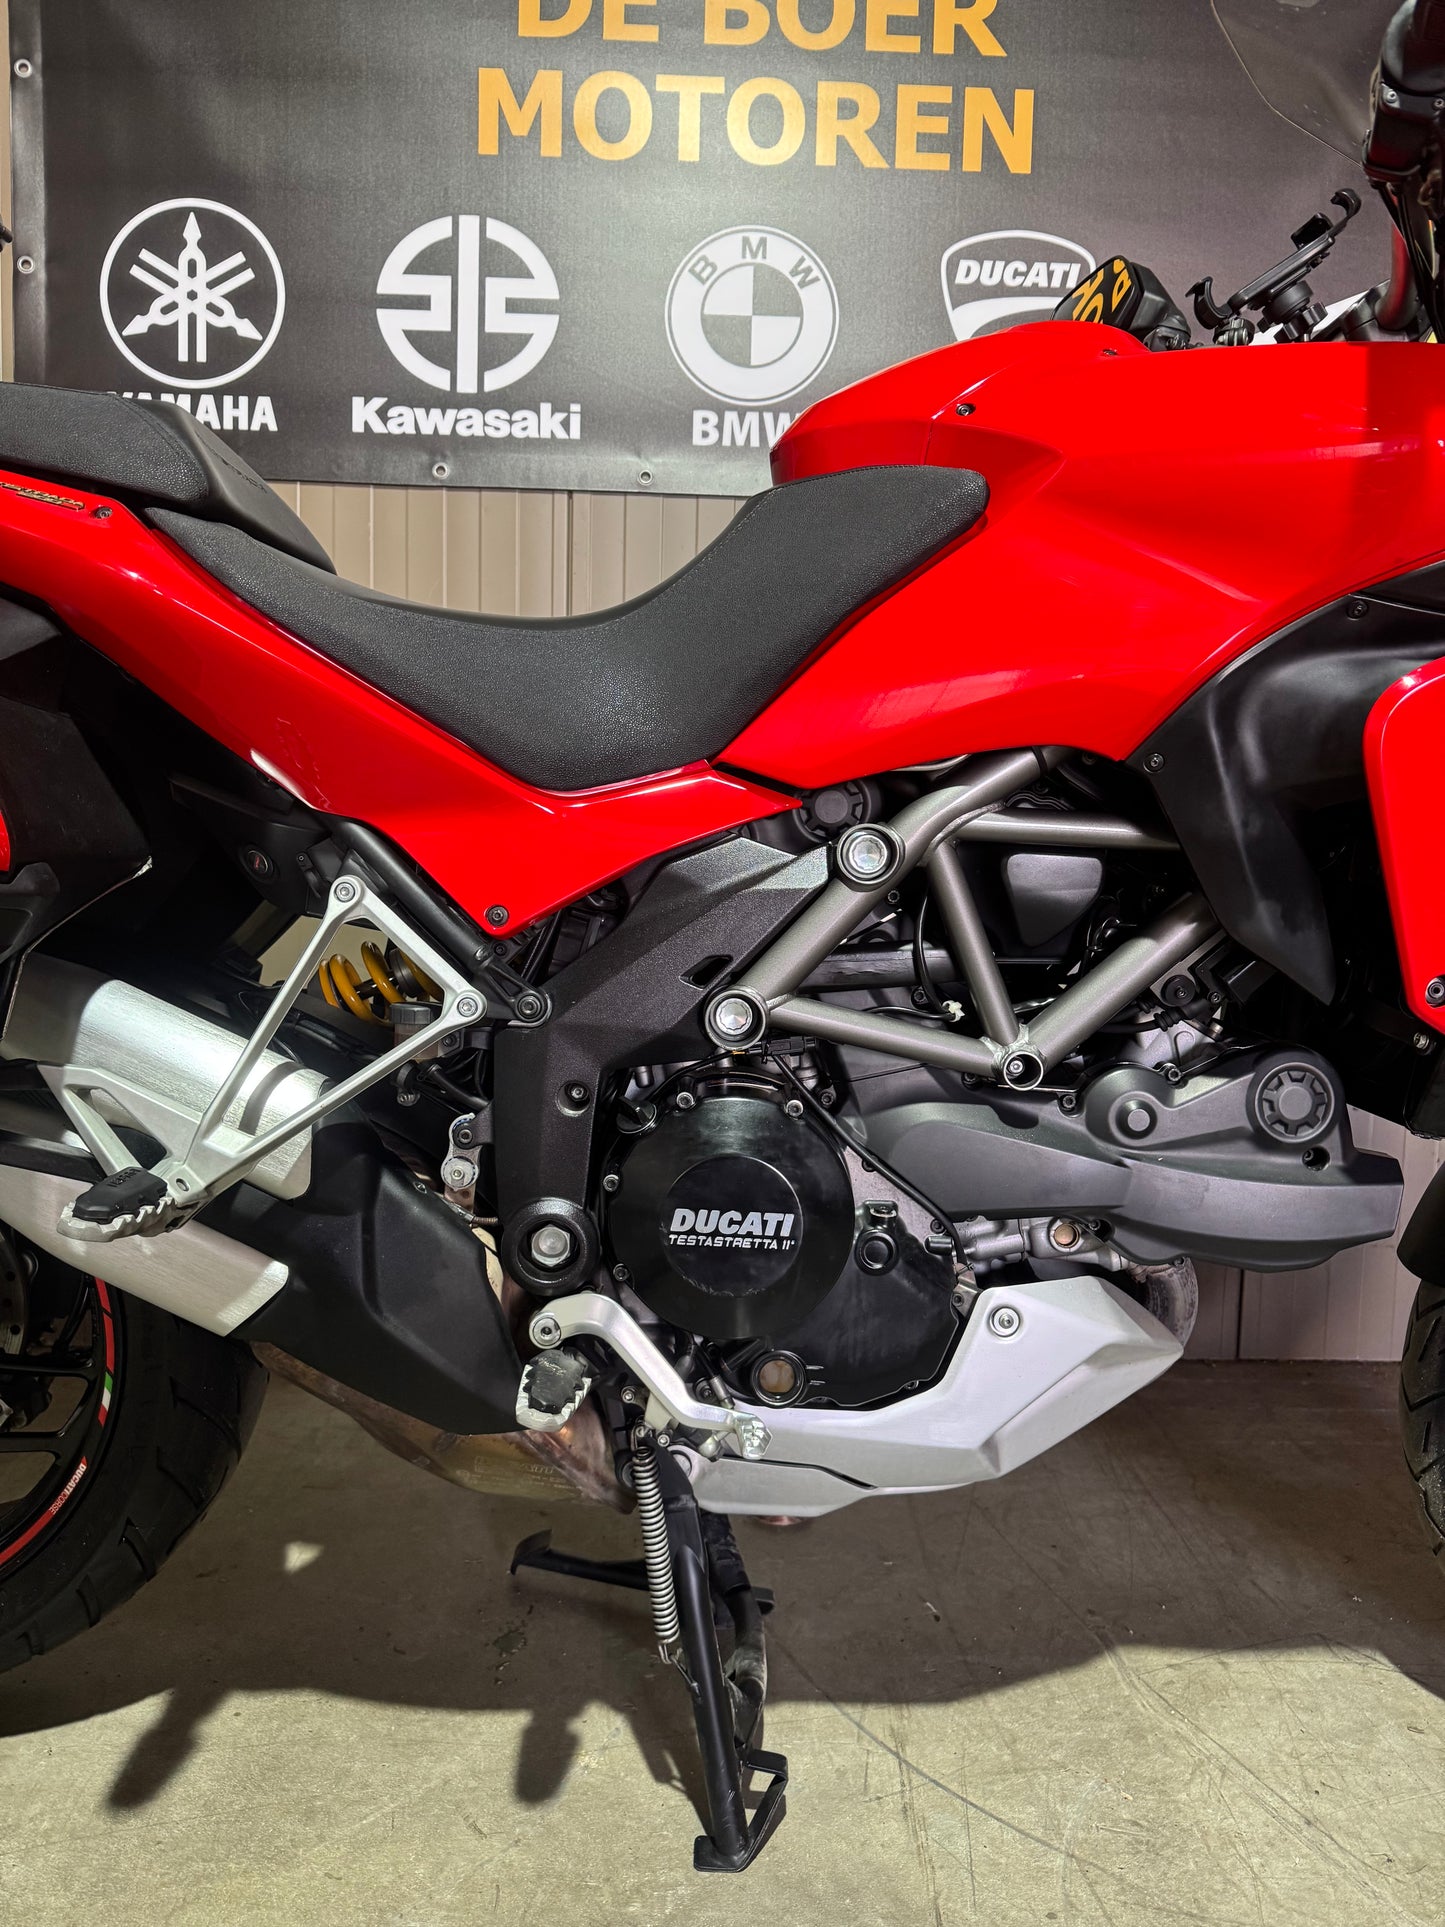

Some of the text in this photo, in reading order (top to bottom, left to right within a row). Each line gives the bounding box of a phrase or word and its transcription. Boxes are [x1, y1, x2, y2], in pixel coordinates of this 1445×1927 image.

[703, 0, 1008, 57] BOER
[477, 67, 1035, 175] MOTOREN
[687, 235, 821, 290] BMW
[954, 259, 1082, 289] DUCATI
[351, 395, 582, 441] Kawasaki
[668, 1234, 778, 1250] TESTASTRETTA
[670, 1208, 795, 1237] DUCATI
